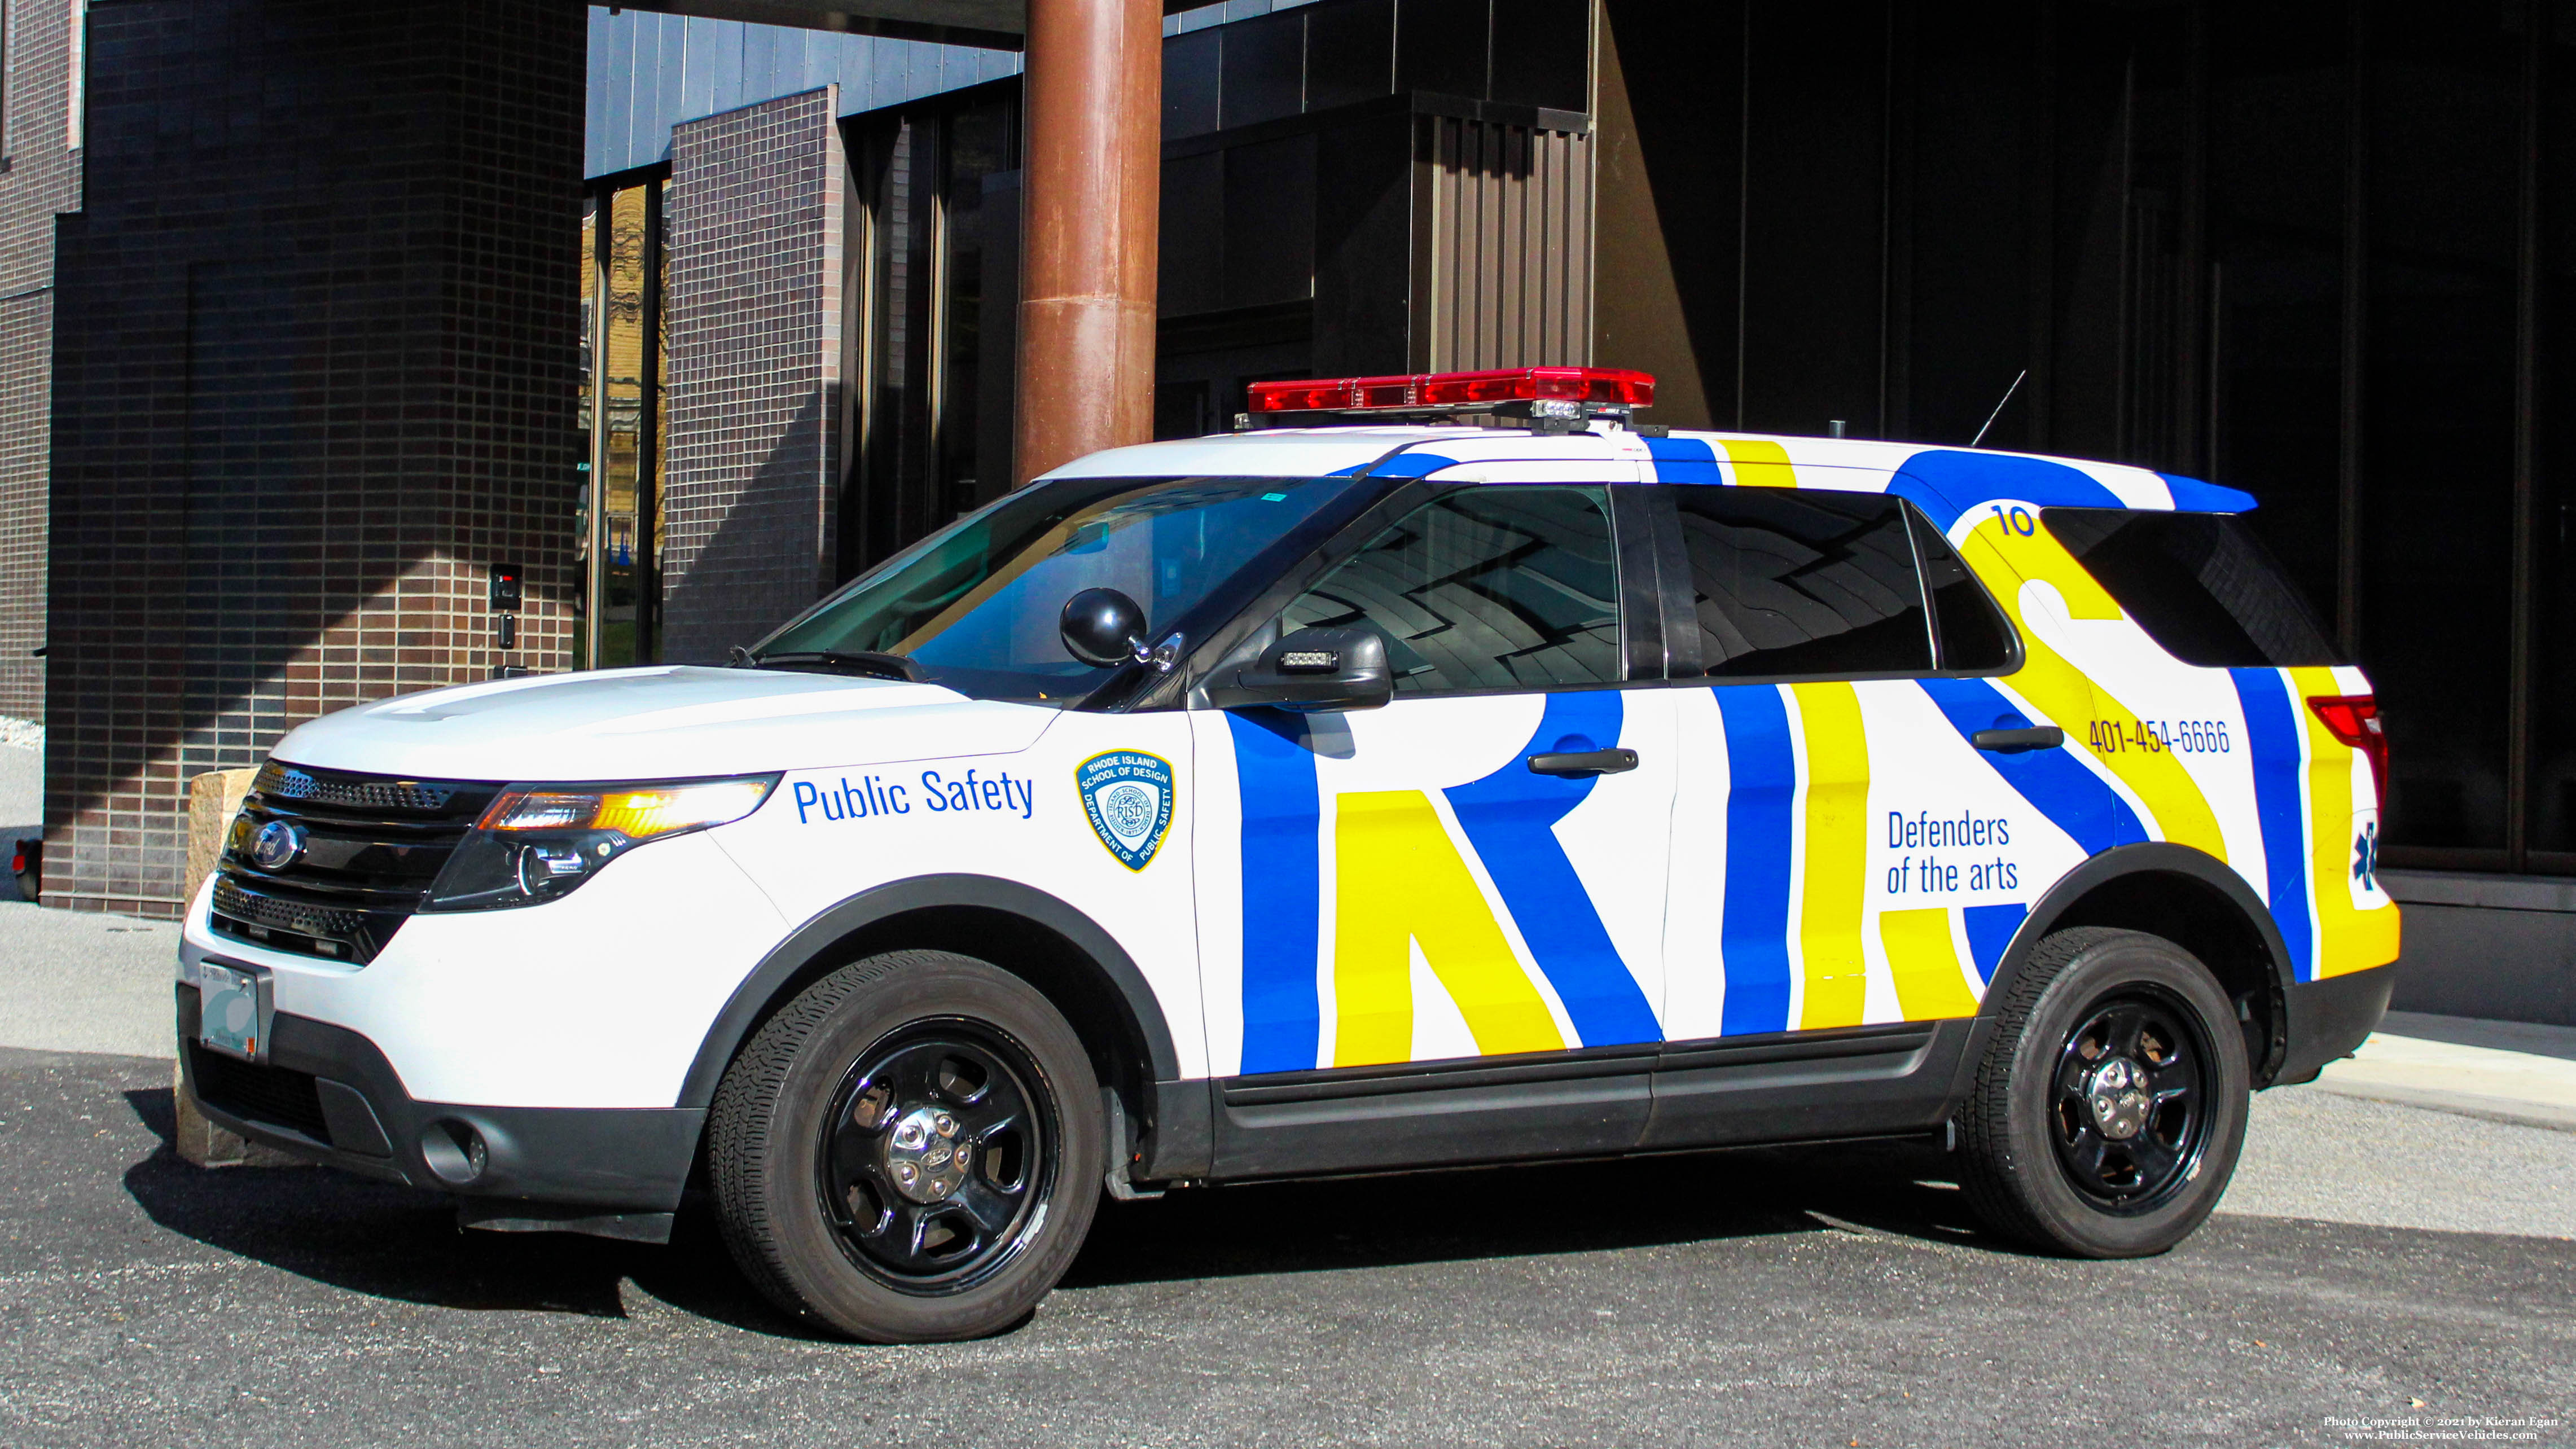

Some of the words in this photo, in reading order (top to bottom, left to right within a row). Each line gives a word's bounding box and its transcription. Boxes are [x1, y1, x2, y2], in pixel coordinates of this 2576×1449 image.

[1990, 504, 2035, 538] 10
[2088, 720, 2231, 754] 401-454-6666
[1081, 772, 1117, 790] SCHOOL
[1118, 767, 1130, 776] OF
[1133, 767, 1169, 784] DESIGN
[1087, 756, 1120, 774] RHODE
[1121, 756, 1157, 769] ISLAND
[793, 776, 910, 824] Public
[921, 769, 1032, 819] Safety
[1115, 800, 1143, 820] RISD
[1122, 788, 1144, 799] SCHOOL
[1083, 793, 1122, 853] DEPARTMENT
[1121, 850, 1134, 862] OF
[1139, 829, 1164, 861] PUBLIC
[1158, 788, 1171, 826] SAFETY
[1889, 810, 2009, 849] Defenders
[1888, 855, 1910, 894] of
[1920, 855, 1959, 893] the
[1971, 857, 2018, 891] arts
